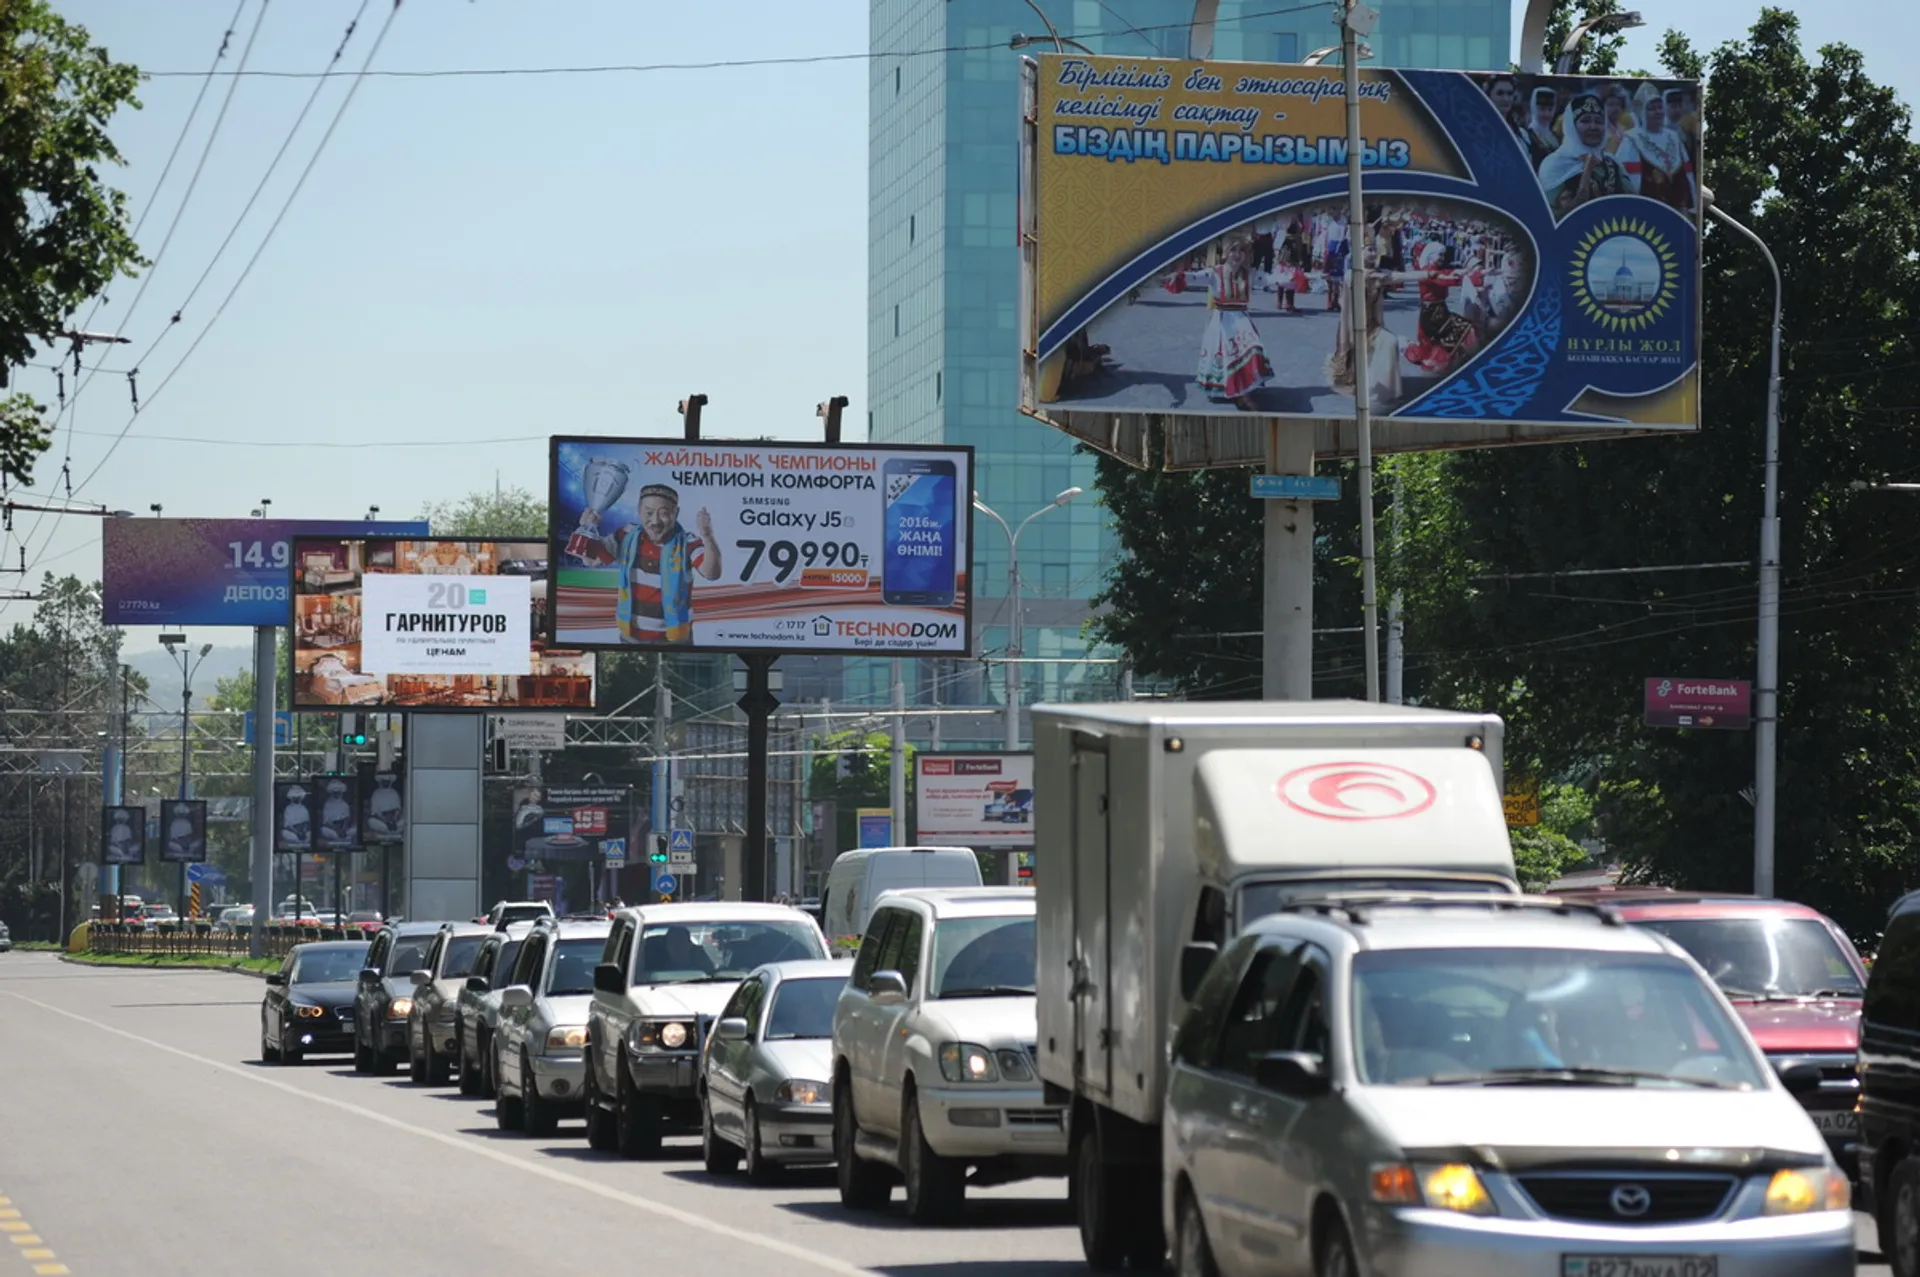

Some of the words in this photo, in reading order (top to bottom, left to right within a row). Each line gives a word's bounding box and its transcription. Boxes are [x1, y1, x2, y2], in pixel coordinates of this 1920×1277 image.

[1058, 60, 1171, 92] Бірлігіміз
[1184, 68, 1221, 91] бен
[1235, 77, 1390, 103] этносараық
[1055, 94, 1163, 126] келісімді
[1173, 104, 1260, 131] сақтау
[1053, 124, 1170, 165] БІЗДІҢ
[1174, 130, 1410, 168] ПАРЫЗЫМЫЗ
[1640, 339, 1681, 352] ЖОЛ
[644, 449, 762, 469] ЖАЙЛЫЛЫҚ
[768, 455, 876, 471] ЧЕМПИОНЫ
[671, 471, 764, 487] ЧЕМПИОН
[771, 474, 876, 490] КОМФОРТА
[742, 497, 790, 506] SAMSUNG
[740, 508, 816, 532] Galaxy
[899, 531, 942, 545] ЖАҢА
[897, 546, 943, 557] ӨНІМІ!
[223, 584, 290, 603] ДЕПОЗ
[427, 582, 466, 609] 20
[385, 613, 507, 633] ГАРНИТУРОВ
[786, 620, 807, 630] 1717
[836, 620, 957, 639] TECHNODOM
[426, 648, 466, 656] ЦЕНАМ
[1677, 684, 1738, 696] ForteBank
